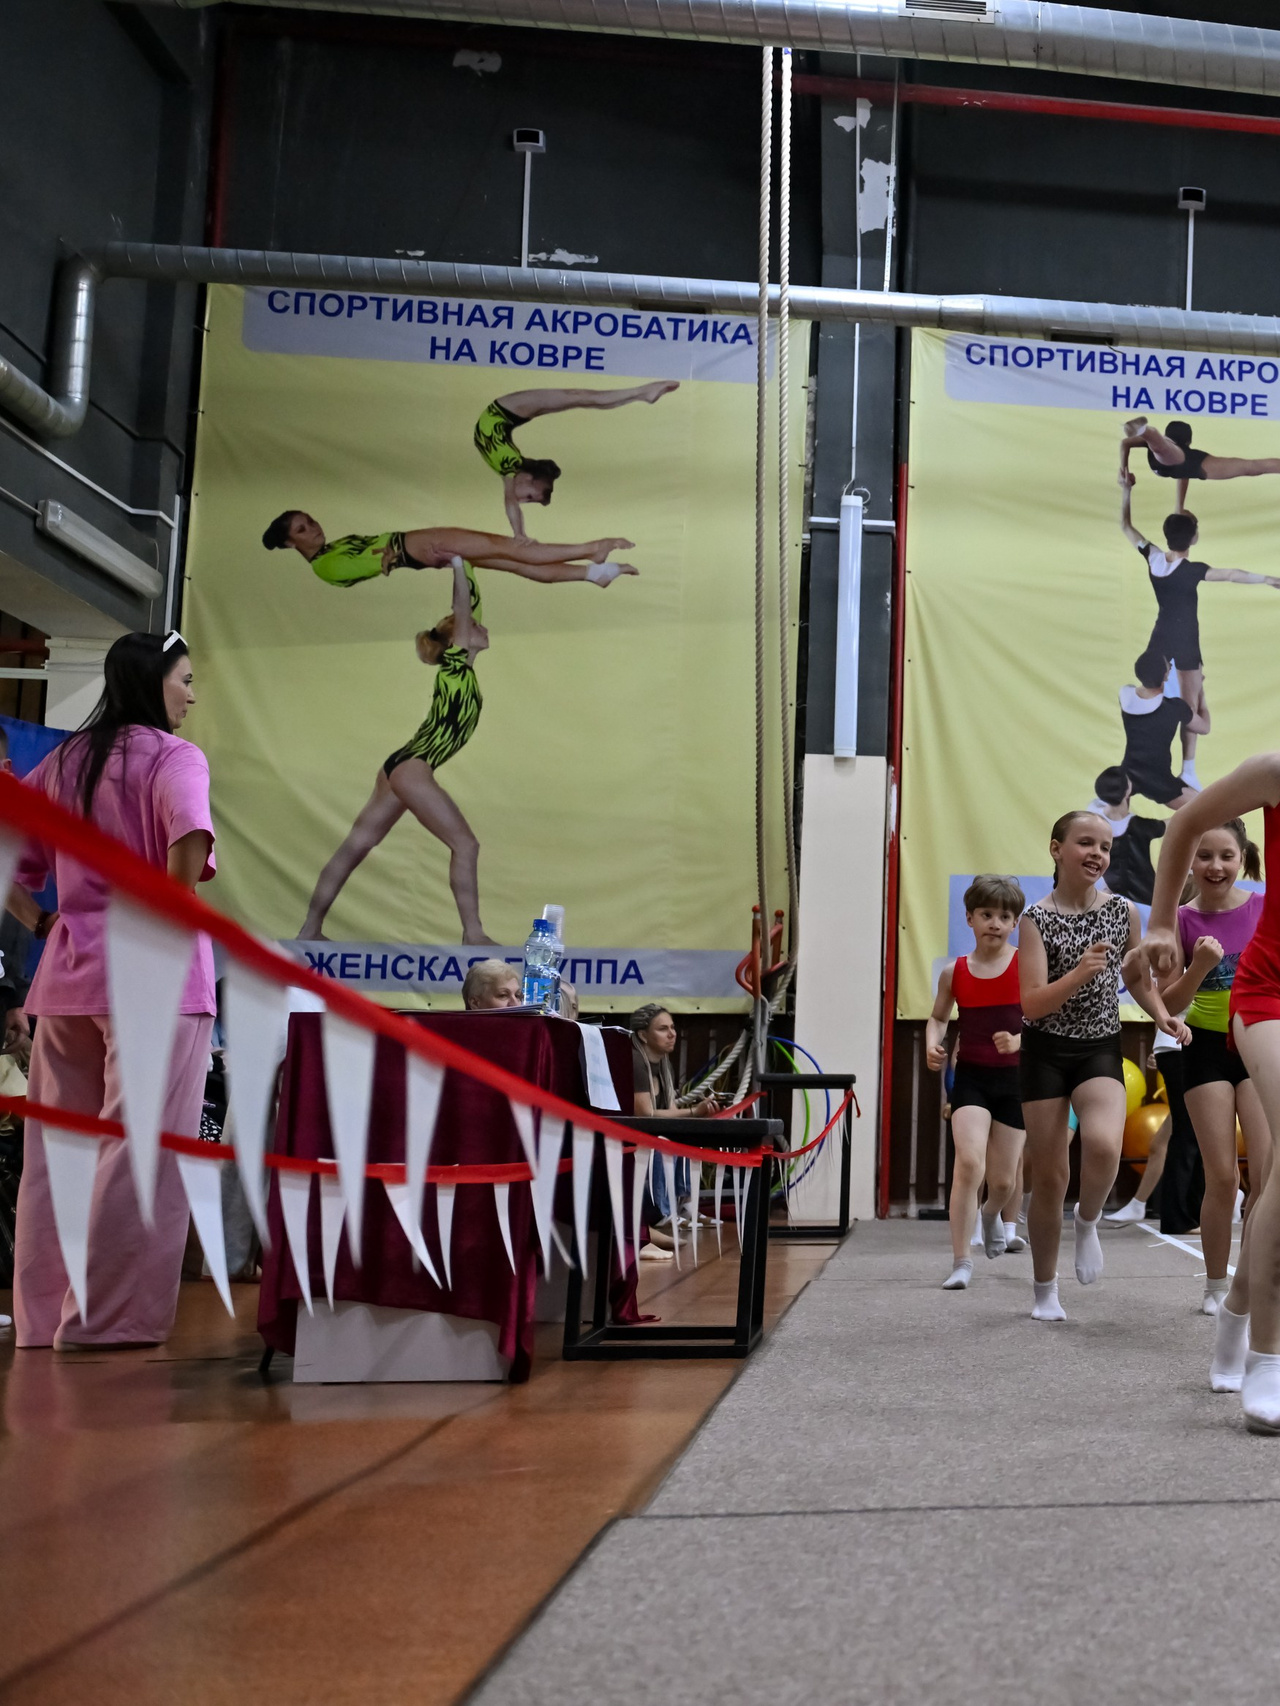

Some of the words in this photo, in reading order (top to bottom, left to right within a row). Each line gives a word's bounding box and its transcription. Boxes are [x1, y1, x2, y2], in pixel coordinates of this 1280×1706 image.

[267, 289, 515, 331] СПОРТИВНАЯ
[524, 307, 754, 346] АКРОБАТИКА
[428, 335, 478, 363] НА
[488, 339, 606, 371] КОВРЕ
[965, 342, 1186, 379] СПОРТИВНАЯ
[1112, 385, 1155, 410] НА
[1165, 388, 1268, 417] КОВРЕ
